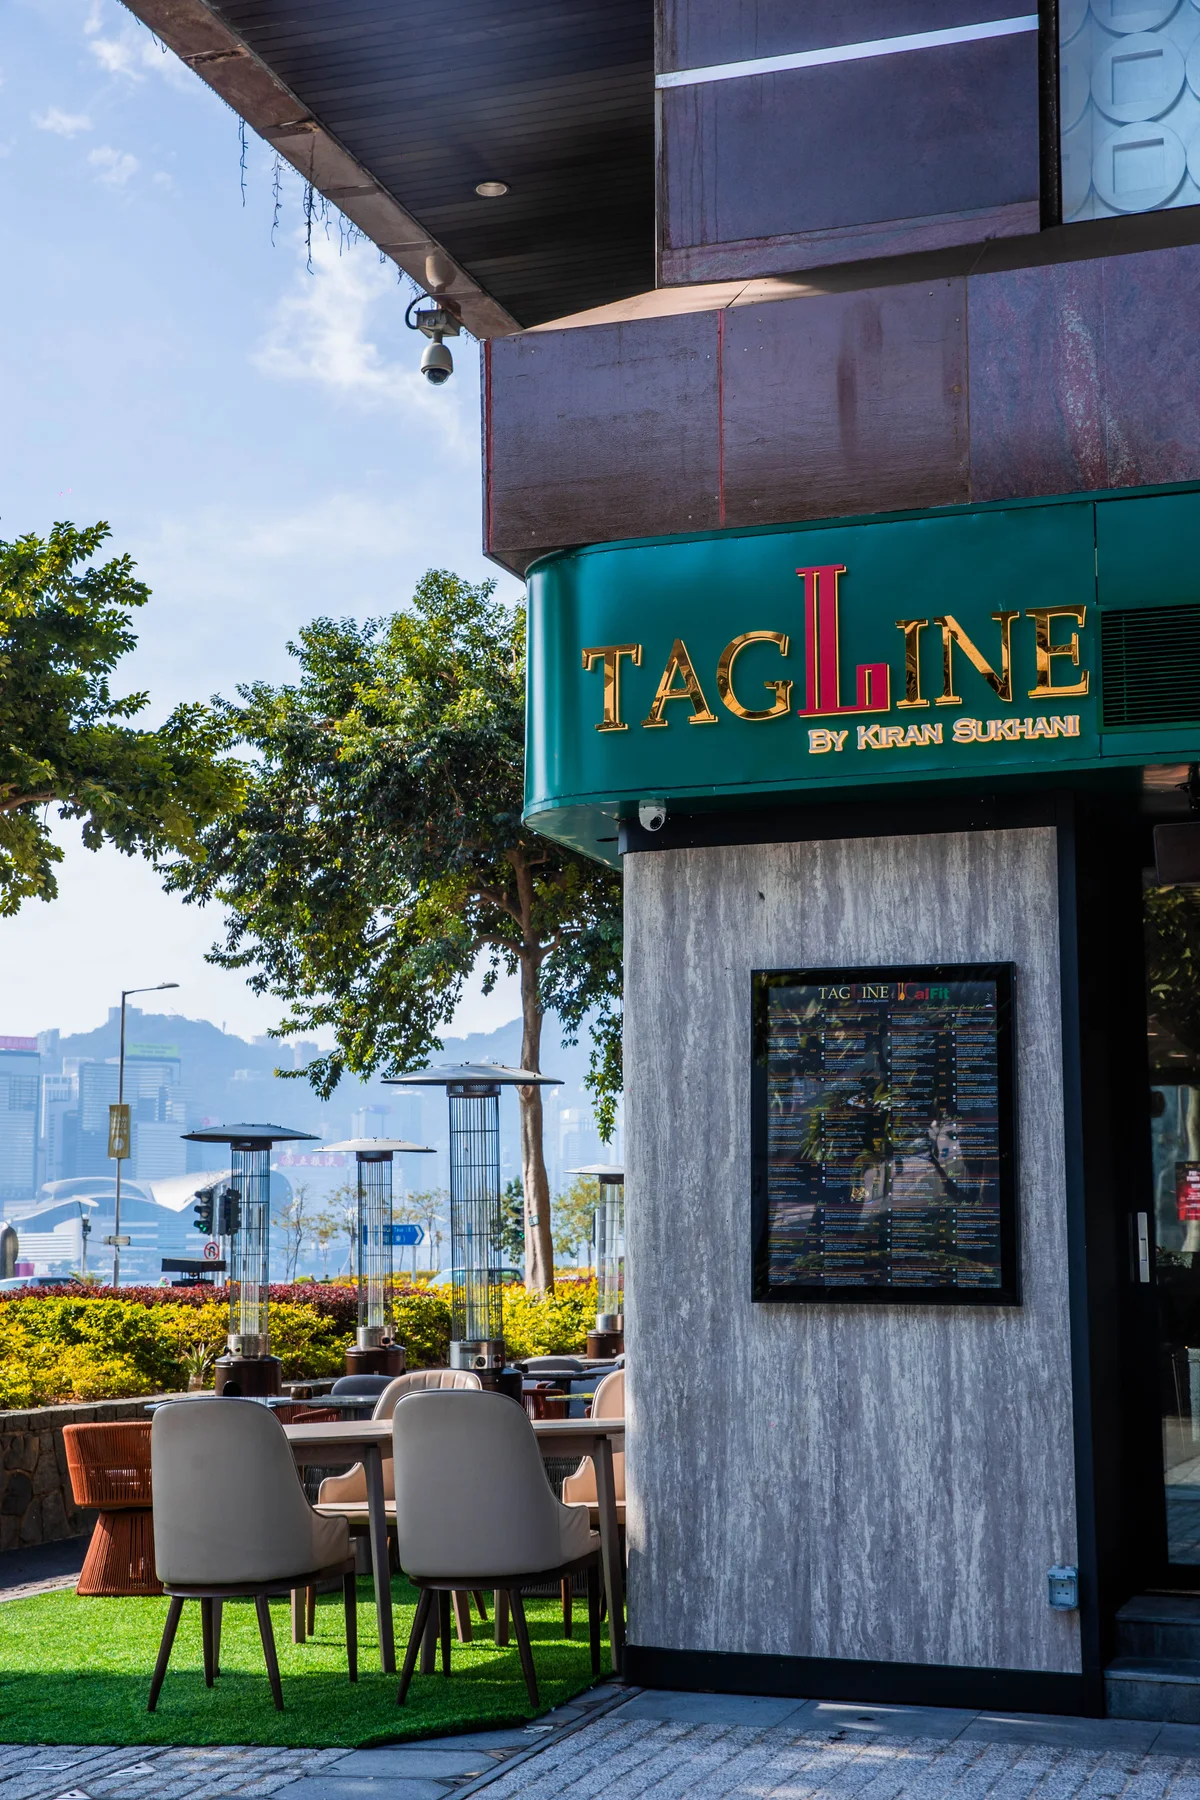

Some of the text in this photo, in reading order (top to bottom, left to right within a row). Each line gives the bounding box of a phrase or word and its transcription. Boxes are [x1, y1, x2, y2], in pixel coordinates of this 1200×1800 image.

[581, 564, 1088, 732] TAGLINE
[857, 724, 943, 749] KIRAN
[952, 715, 1080, 742] SUKHANI
